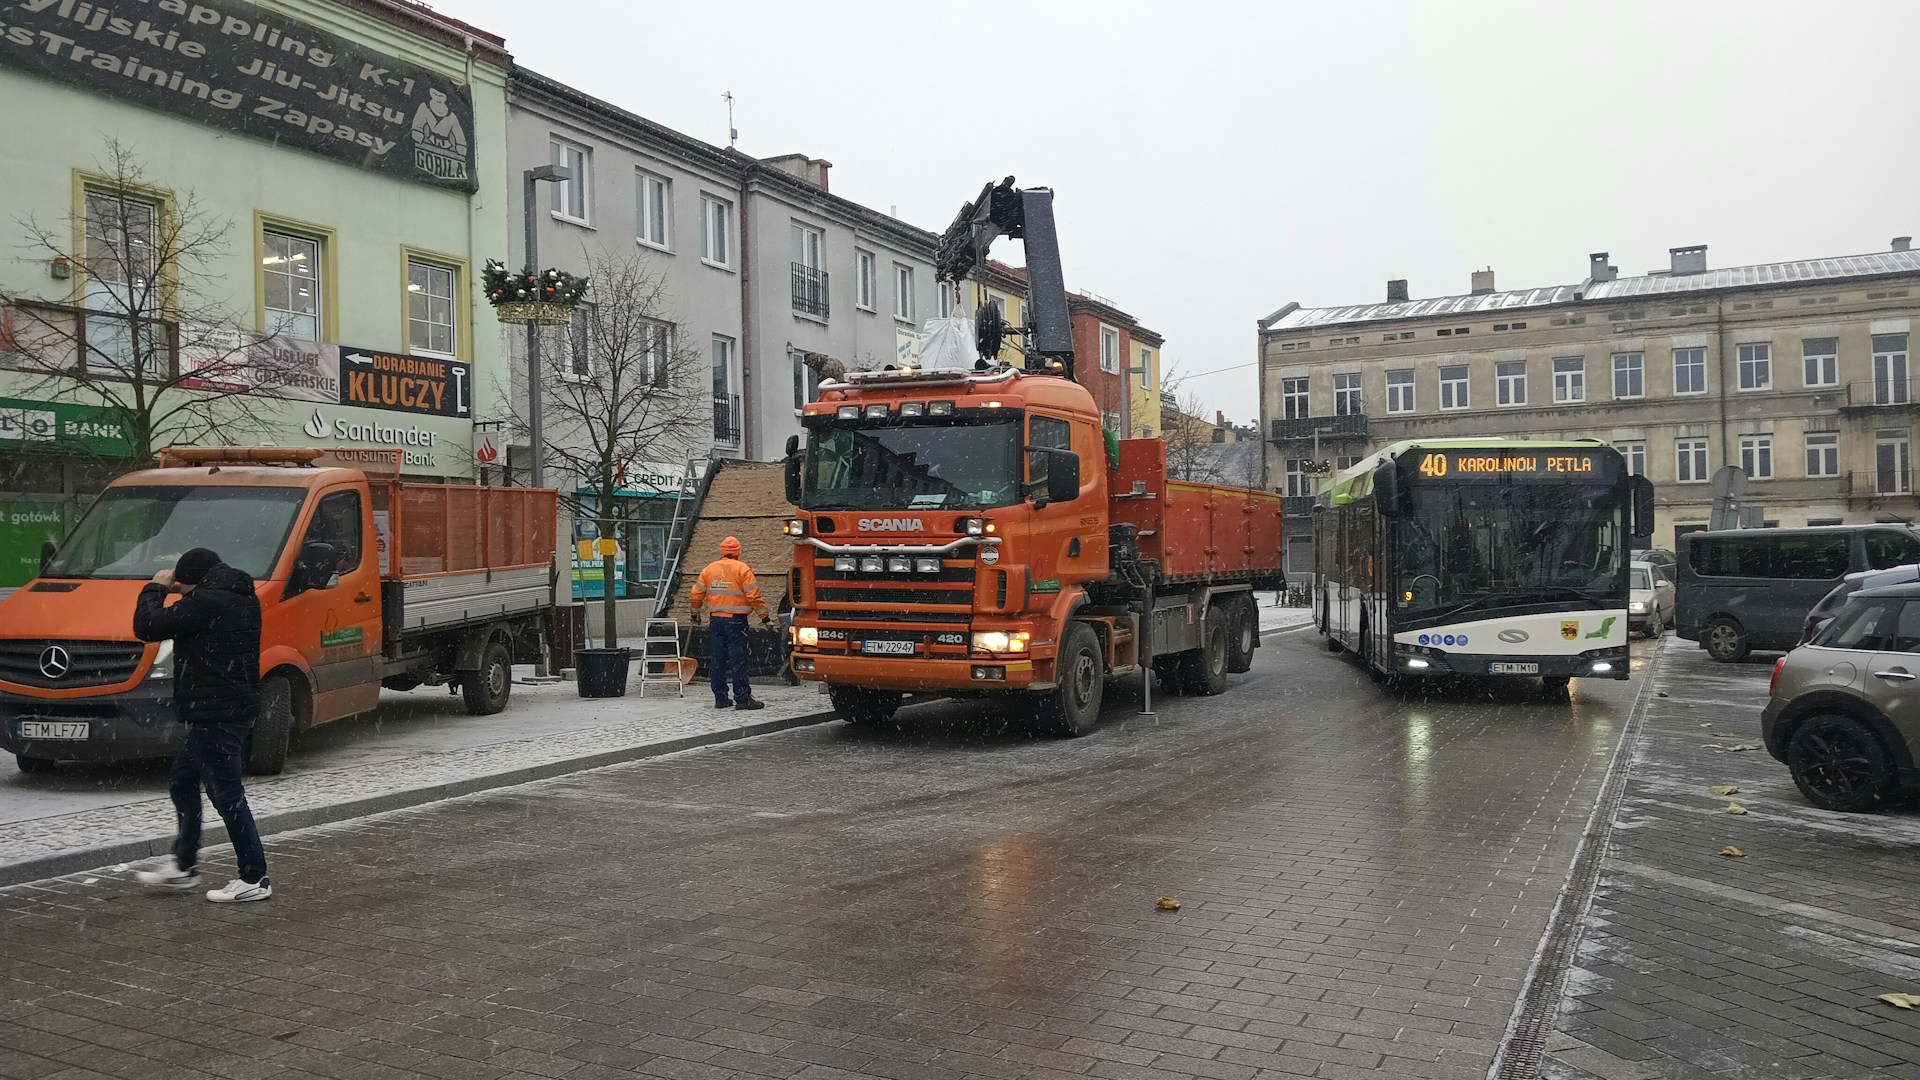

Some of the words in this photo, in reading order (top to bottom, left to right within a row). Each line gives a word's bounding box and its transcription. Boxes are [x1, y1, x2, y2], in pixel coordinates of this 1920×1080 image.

[137, 0, 334, 68] appling
[359, 62, 415, 96] K-1
[0, 21, 243, 109] sTraining
[253, 96, 396, 155] Zapasy
[237, 58, 405, 125] Jiu-Jitsu
[416, 149, 467, 179] GORILA
[272, 347, 319, 367] USŁUGI
[373, 354, 446, 379] DORABIANIE
[255, 369, 336, 392] GRAWERSKIE
[349, 370, 446, 410] KLUCZY
[64, 420, 122, 439] BANK
[334, 417, 438, 447] Santander
[335, 445, 401, 464] Consume
[404, 450, 437, 467] Bank
[1419, 453, 1448, 477] 40
[1458, 456, 1538, 472] KAROLINÓW
[634, 473, 675, 487] CREDIT
[857, 517, 925, 532] SCANIA
[1405, 591, 1413, 602] 9
[866, 641, 883, 651] ETM
[886, 642, 913, 654] 22947
[937, 634, 964, 643] 420
[1493, 663, 1514, 672] ETM
[23, 723, 50, 737] ETM
[54, 724, 87, 738] LF77
